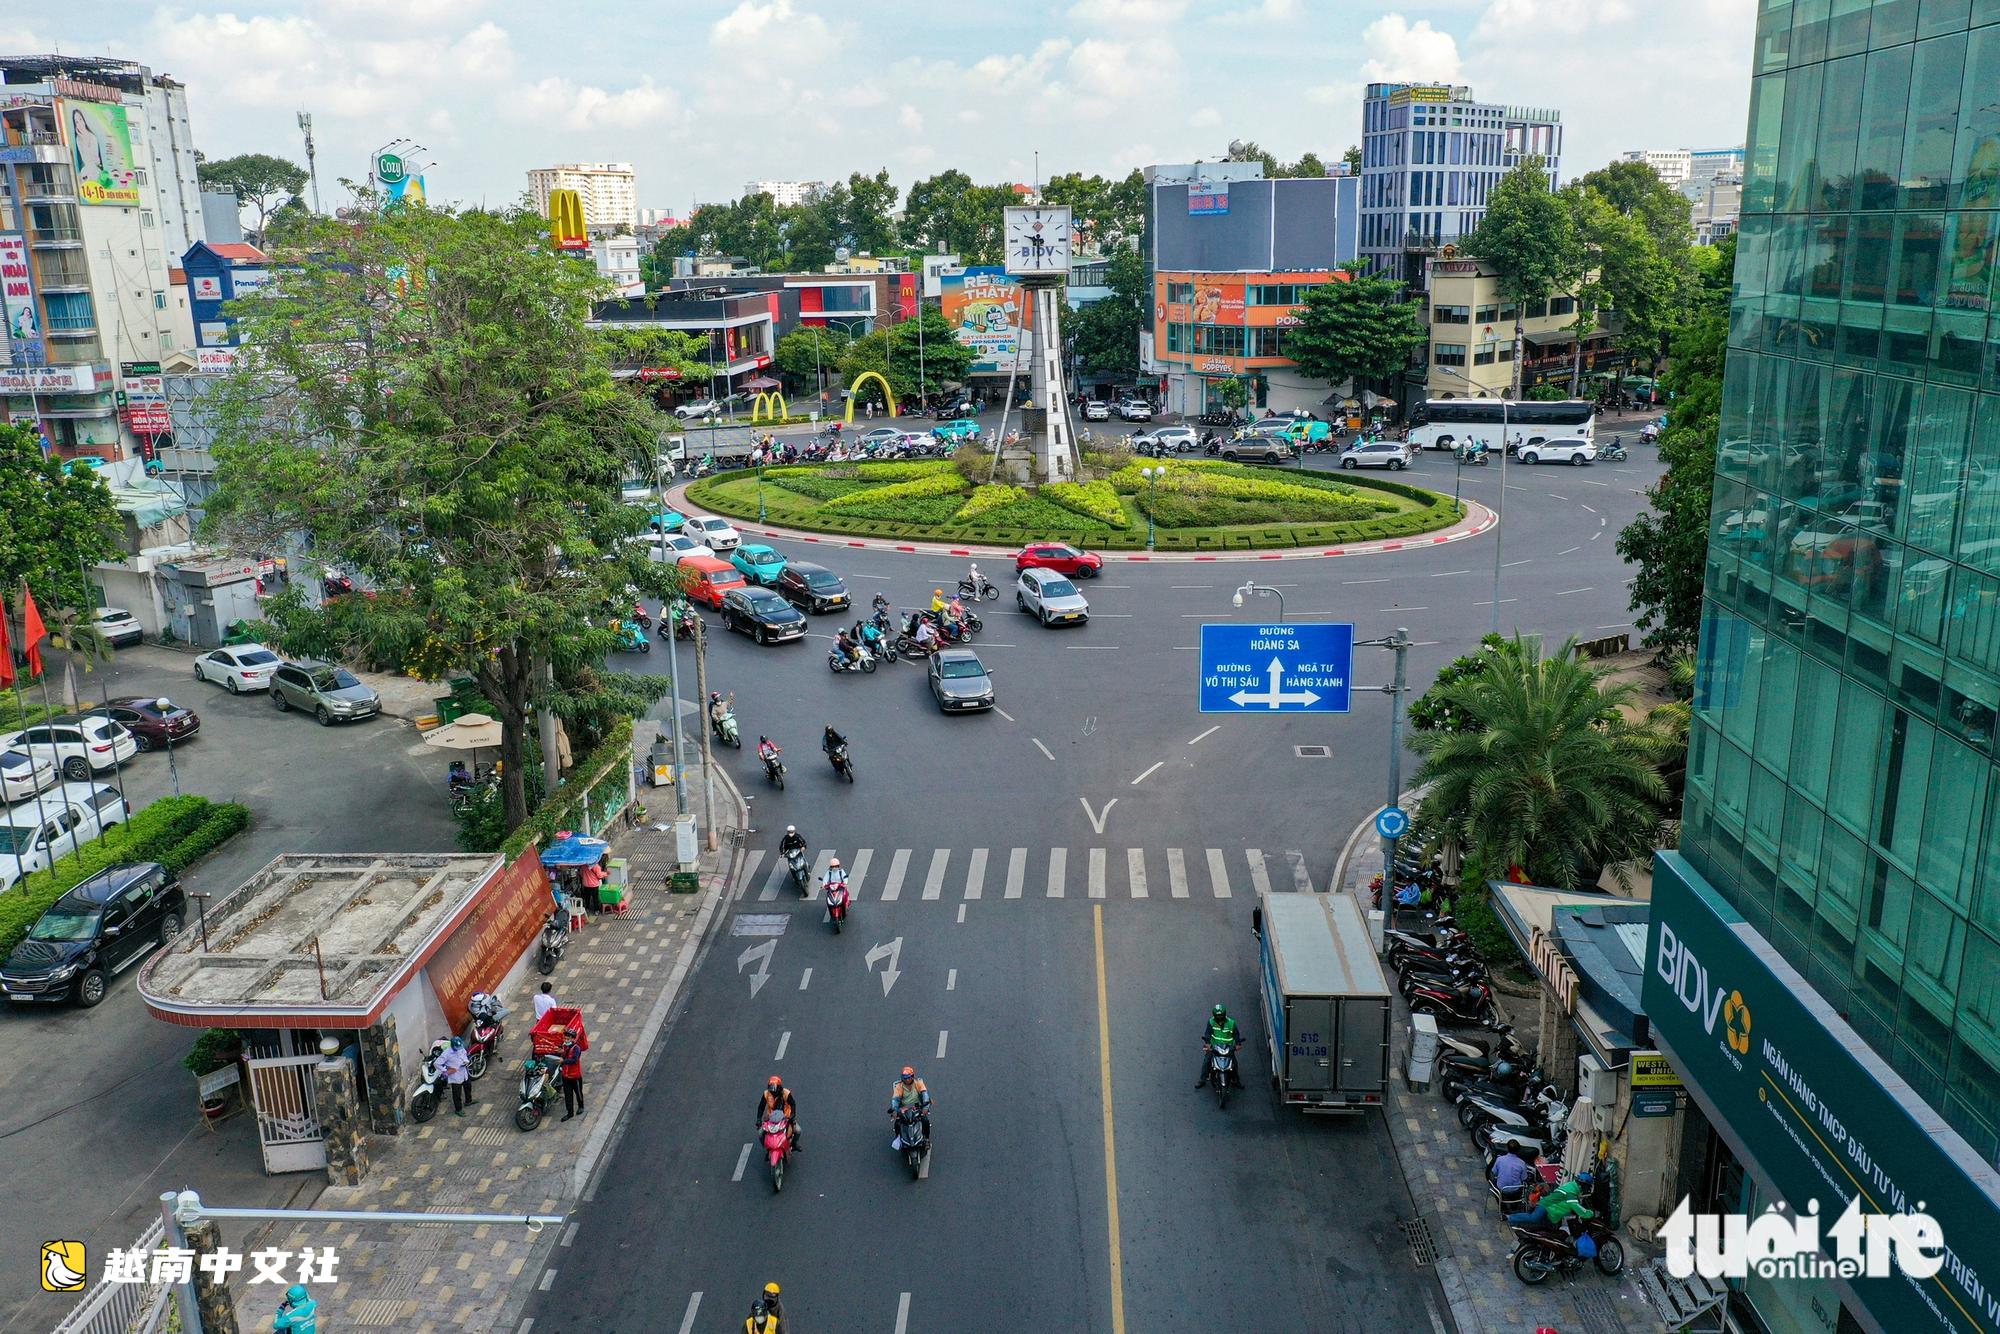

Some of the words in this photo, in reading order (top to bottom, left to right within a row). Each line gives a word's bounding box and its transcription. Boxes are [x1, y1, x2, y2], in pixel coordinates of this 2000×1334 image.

[380, 158, 400, 178] Cozy
[82, 186, 105, 199] 14-16
[1022, 246, 1054, 257] BIDV
[2, 262, 28, 278] HOÀI
[8, 282, 30, 296] ANH
[40, 375, 72, 386] ANH
[1259, 626, 1294, 635] ĐƯỜNG
[1250, 638, 1284, 650] HOÀNG
[1288, 640, 1300, 650] SA
[1217, 662, 1251, 672] ĐƯỜNG
[1298, 664, 1318, 672] NGÃ
[1320, 664, 1334, 672] TƯ
[1222, 677, 1237, 688] THỊ
[1240, 675, 1259, 687] SÁU
[1286, 675, 1313, 687] HÀNG
[1316, 678, 1343, 687] XANH
[1529, 927, 1580, 1016] KATINAT
[1657, 921, 1727, 1036] BIDV
[1763, 1038, 1789, 1080] NGÂN
[1789, 1068, 1817, 1112] HÀNG
[1819, 1100, 1846, 1143] TMCP
[1848, 1136, 1872, 1174] ĐẦU
[1873, 1163, 1891, 1194] TƯ
[1944, 1244, 1985, 1307] TRIỂN
[1812, 1296, 1832, 1330] BIDV
